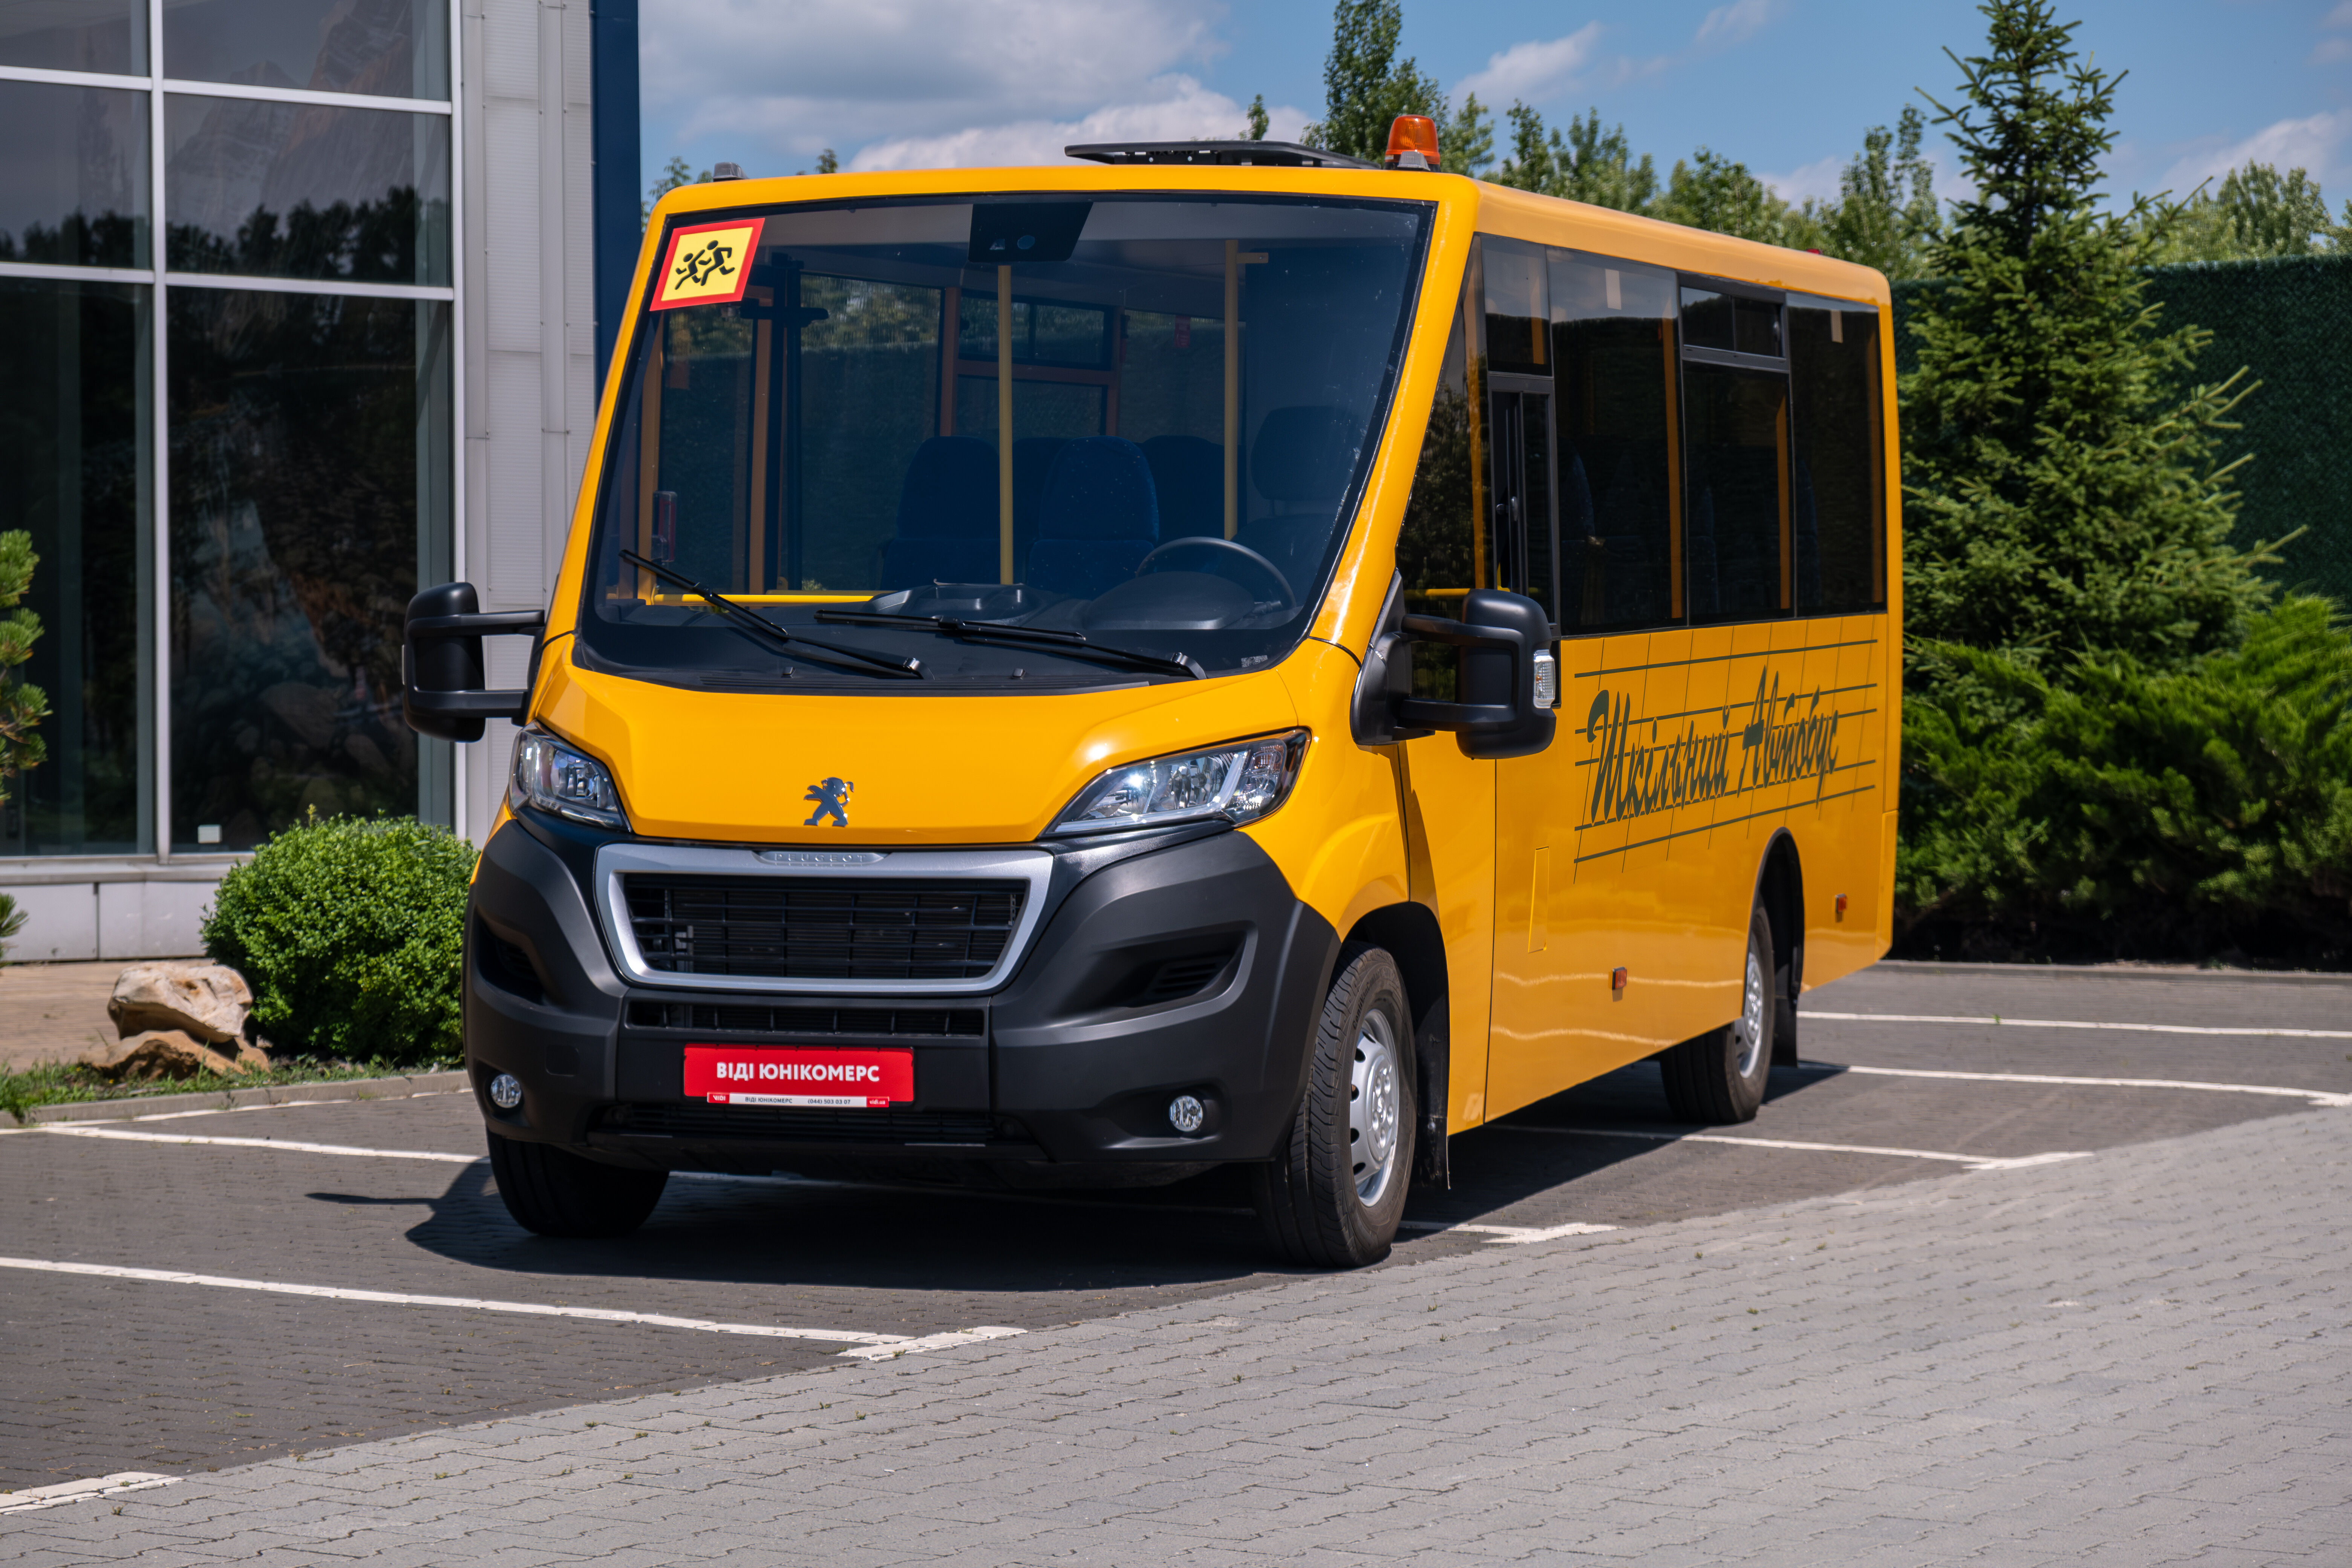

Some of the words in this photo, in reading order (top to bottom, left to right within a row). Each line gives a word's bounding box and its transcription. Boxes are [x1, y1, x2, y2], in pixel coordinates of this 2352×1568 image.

[775, 853, 865, 862] PEUGEOT
[717, 1062, 754, 1081] ВІДІ
[759, 1063, 880, 1082] ЮНІКОМЕРС
